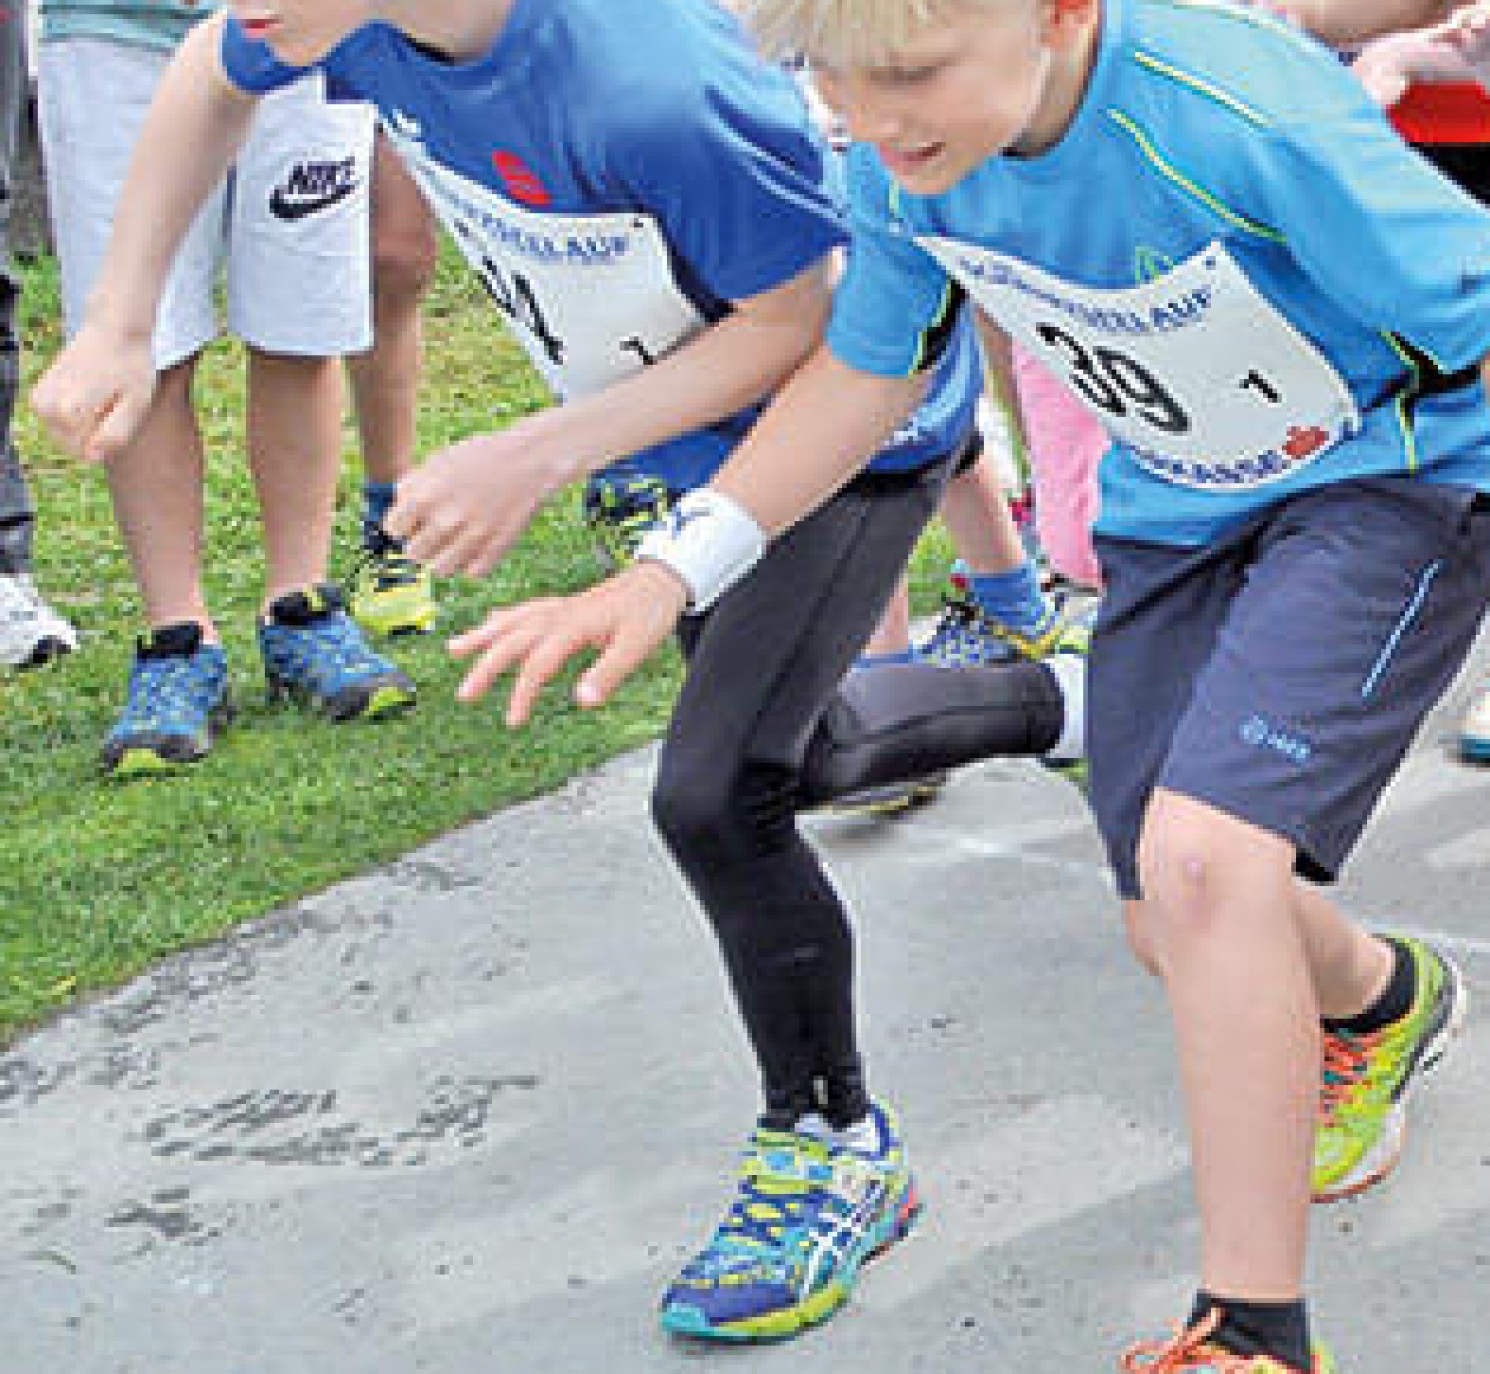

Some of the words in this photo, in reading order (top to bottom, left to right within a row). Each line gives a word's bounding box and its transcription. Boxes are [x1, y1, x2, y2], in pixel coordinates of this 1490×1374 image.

[285, 155, 358, 194] NIKE
[1036, 323, 1191, 434] 39
[1241, 369, 1281, 403] 1
